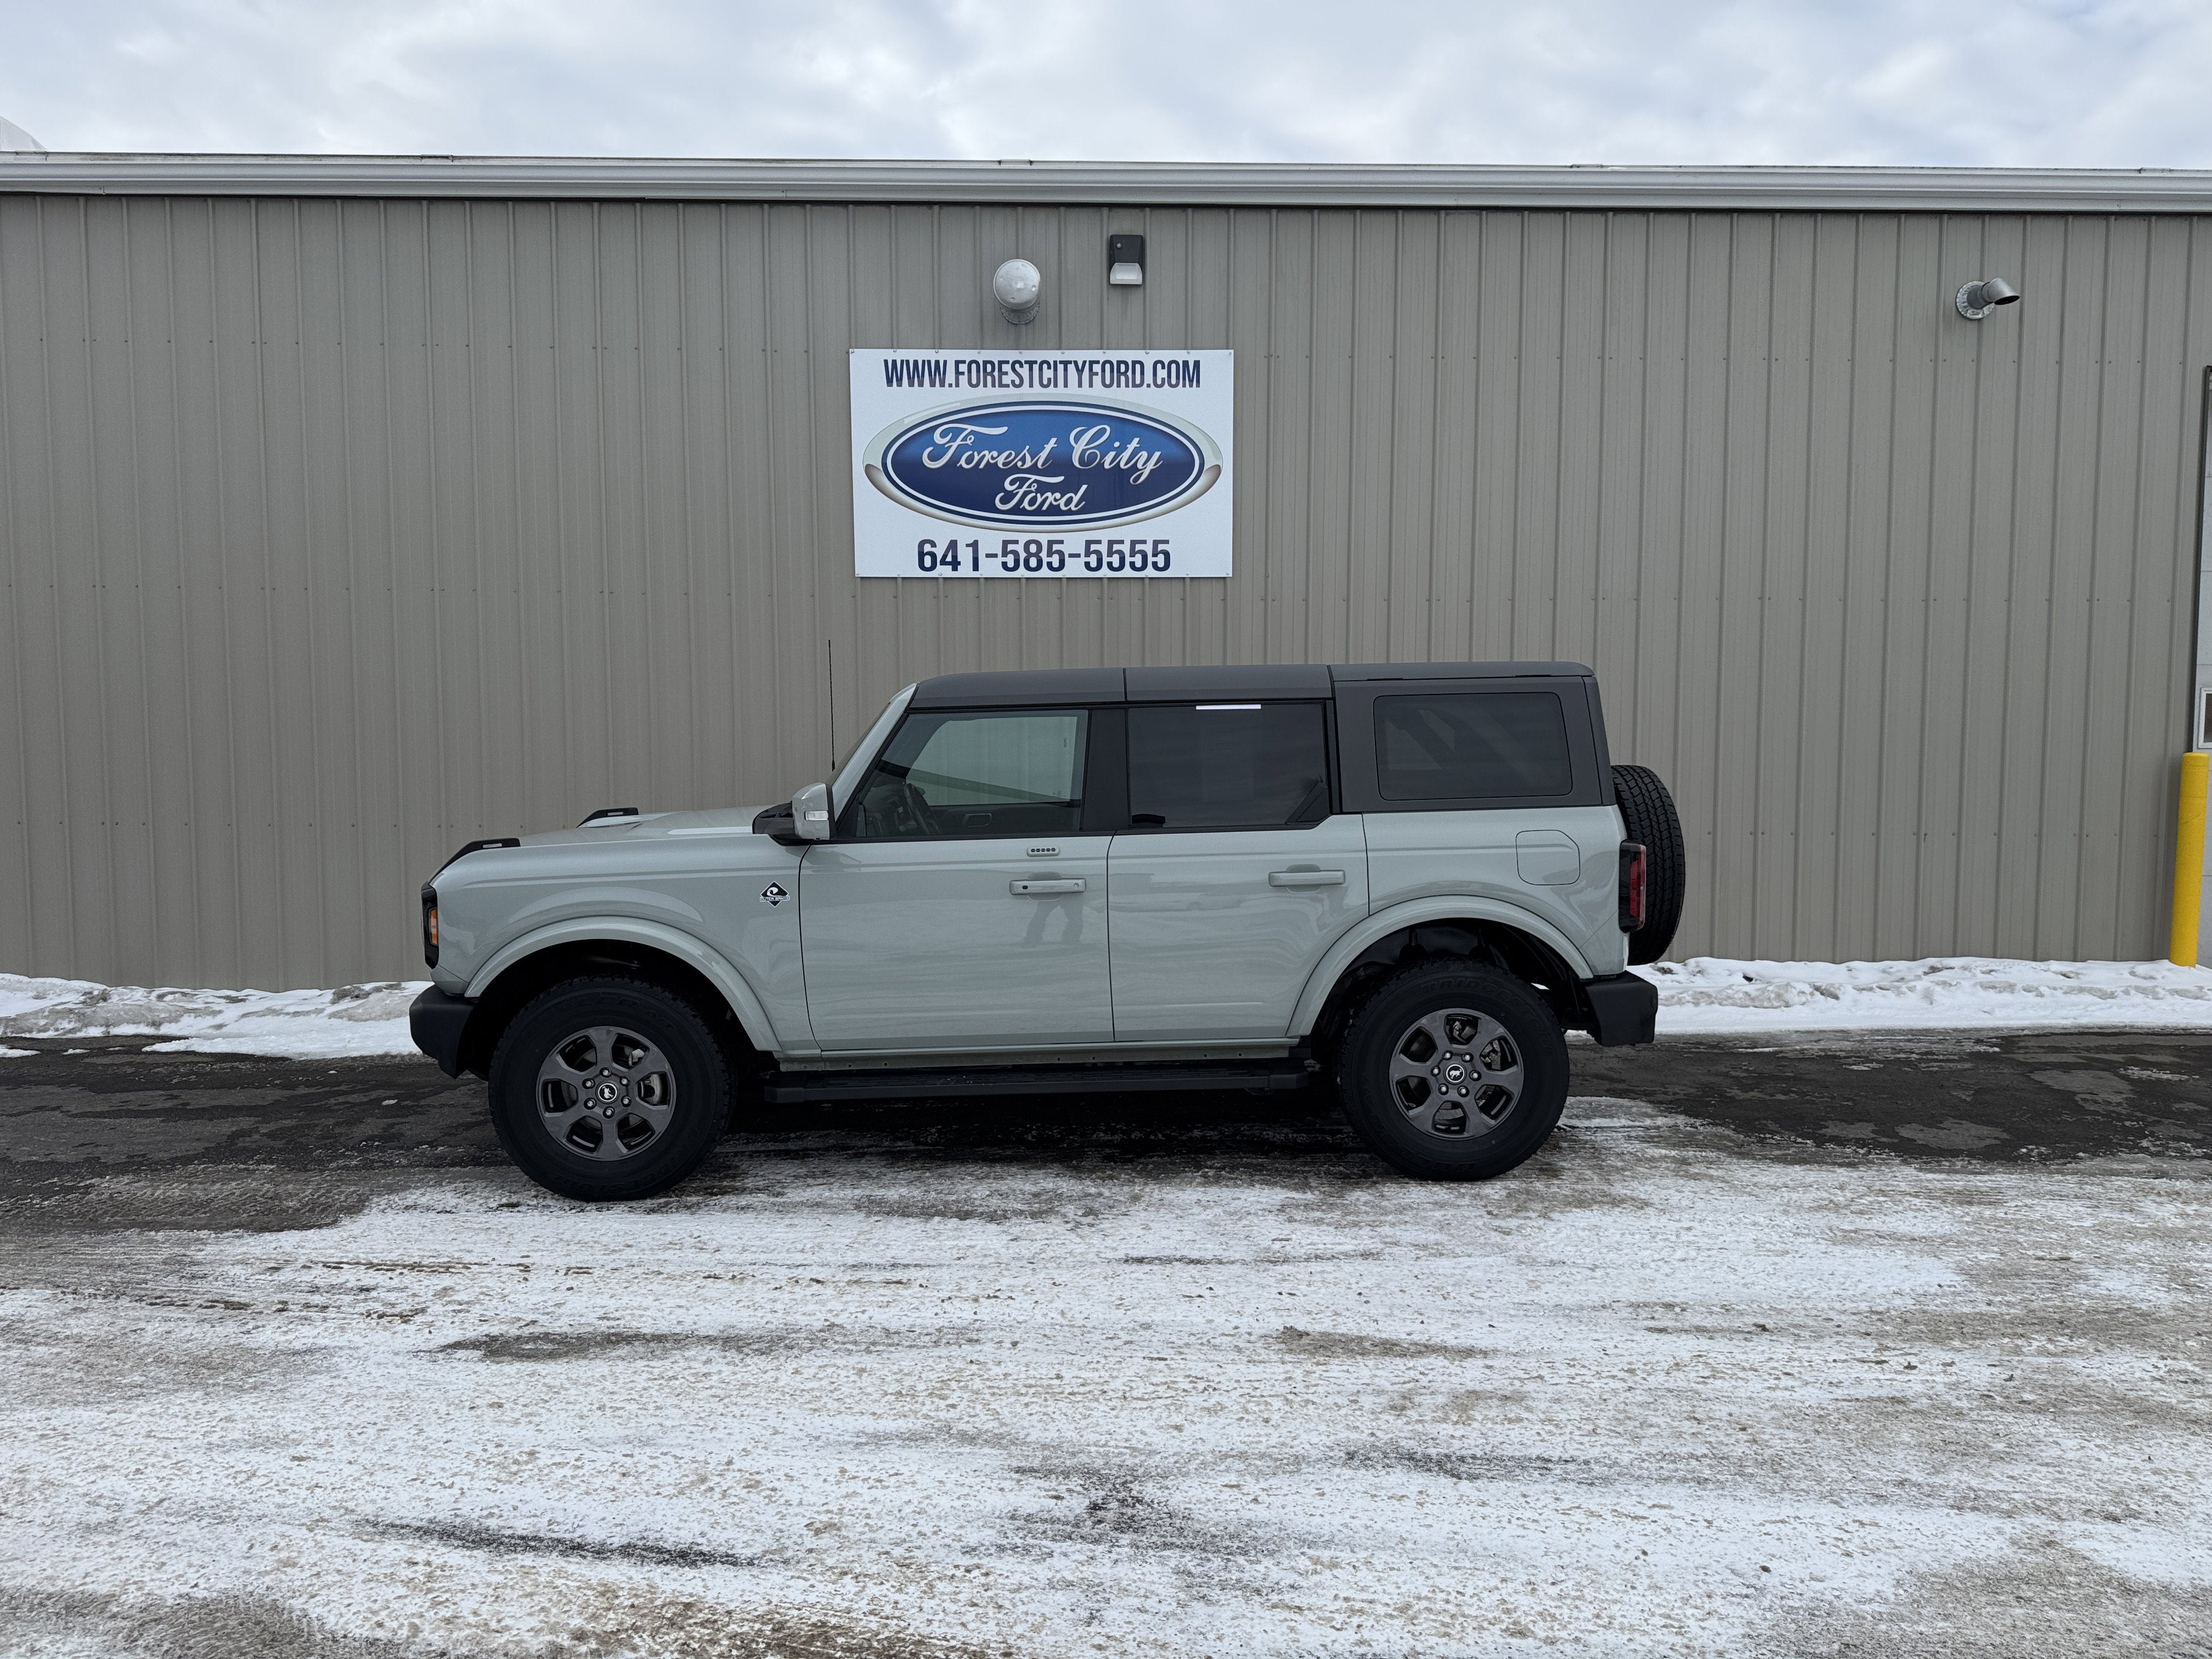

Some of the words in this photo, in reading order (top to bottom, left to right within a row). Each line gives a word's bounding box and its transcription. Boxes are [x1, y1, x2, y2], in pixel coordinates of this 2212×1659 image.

[883, 358, 1201, 388] WWW.FORESTCITYFORD.COM
[922, 423, 1058, 470] Forest
[1069, 424, 1164, 485] City
[995, 473, 1088, 511] Ford
[917, 539, 1171, 572] 641-585-5555
